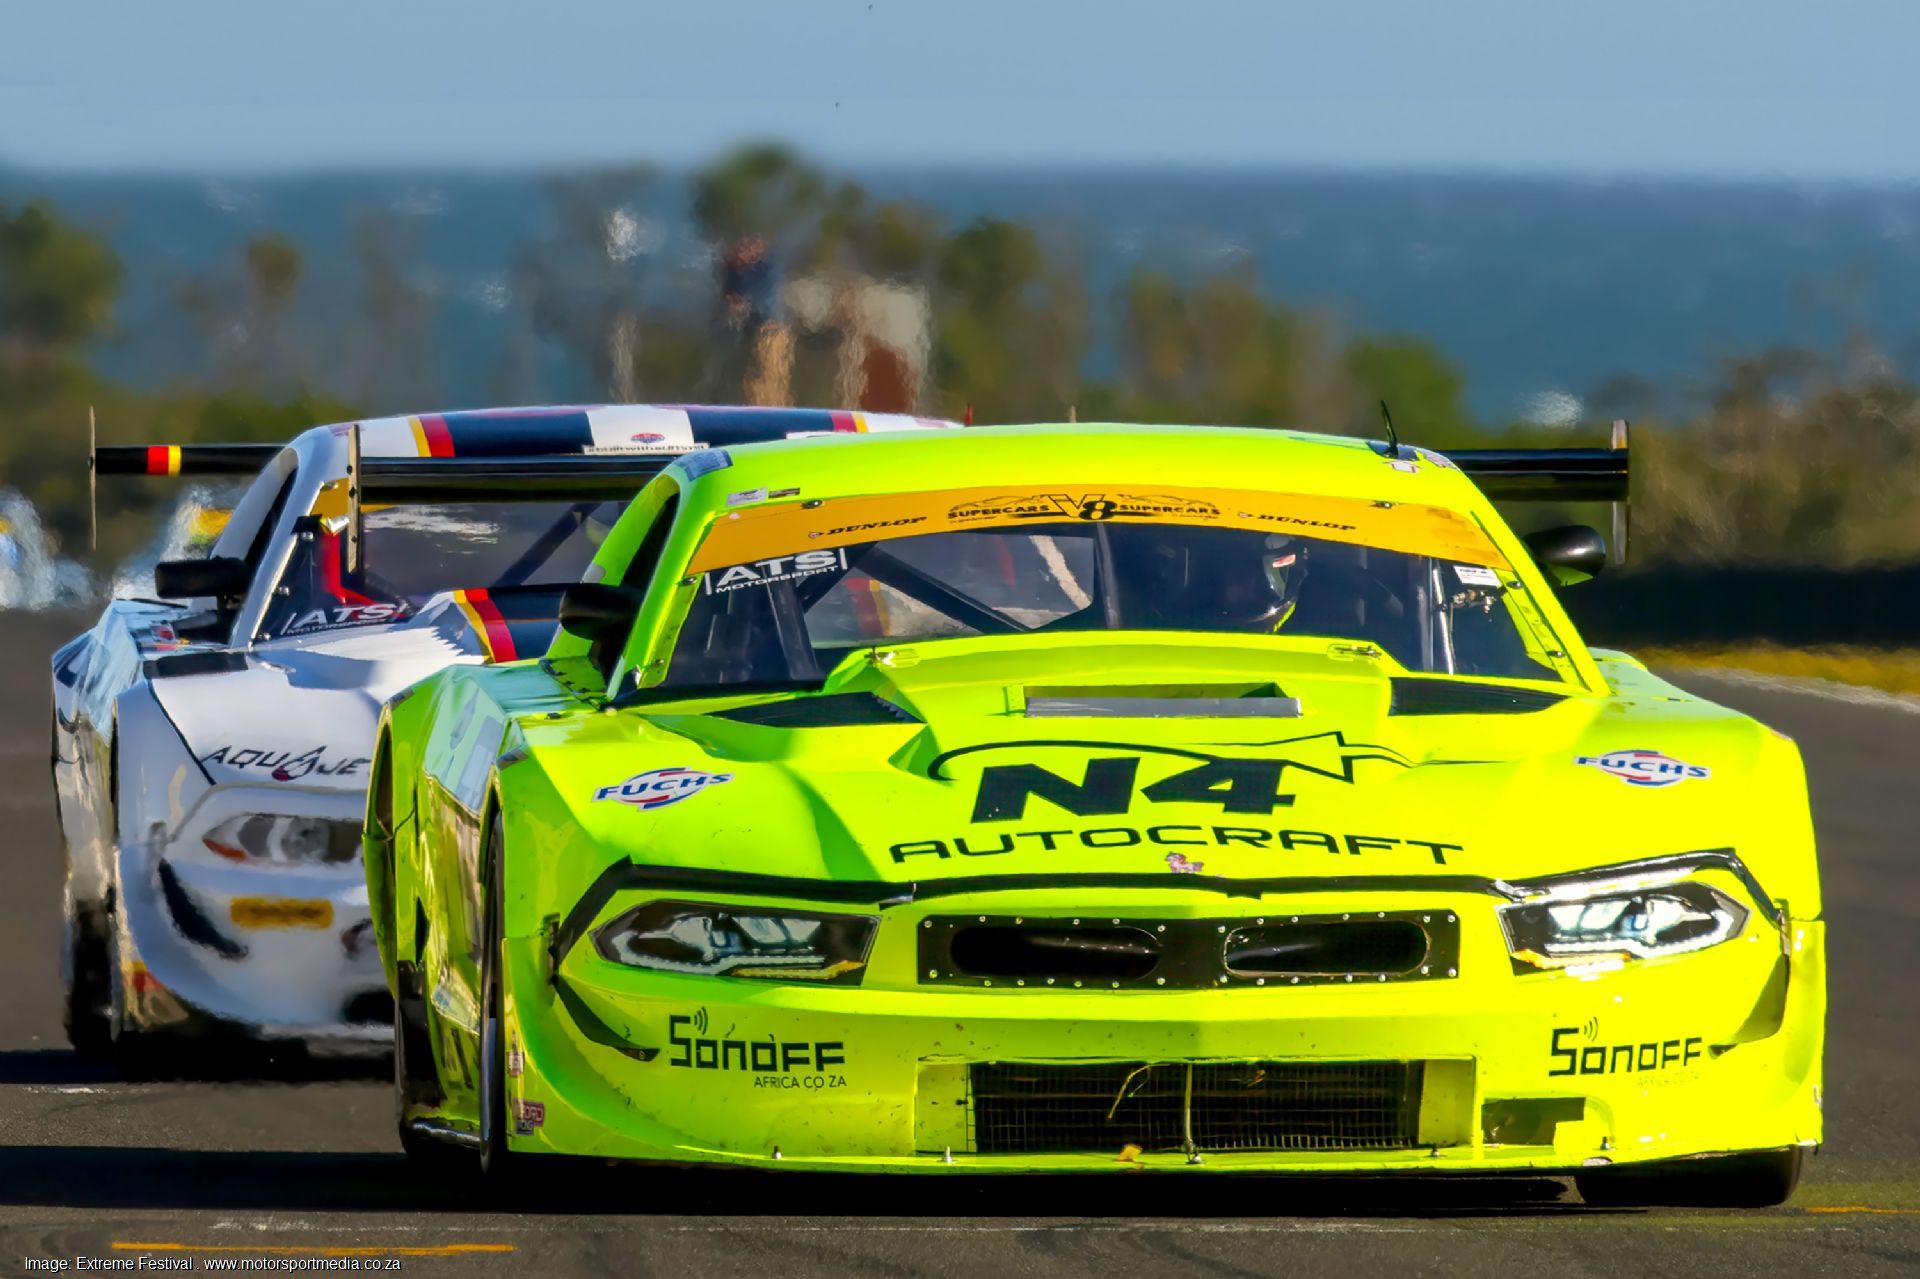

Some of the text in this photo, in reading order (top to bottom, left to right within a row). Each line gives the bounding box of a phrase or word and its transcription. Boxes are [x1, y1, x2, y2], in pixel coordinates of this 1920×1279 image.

[948, 504, 1051, 520] SUPERCARS
[1041, 493, 1118, 521] V8
[1118, 503, 1221, 516] SUPERCARS
[827, 516, 928, 536] DUNLOP
[1257, 513, 1357, 531] DUNLOP
[715, 564, 839, 594] MOTORSPORT
[716, 549, 837, 588] ATS
[292, 603, 398, 629] ATS
[1577, 756, 1708, 778] FUCHS
[596, 773, 732, 801] FUCHS
[970, 756, 1297, 824] N4
[888, 824, 1464, 866] AUTOCRAFT
[753, 1075, 800, 1089] AFRICA
